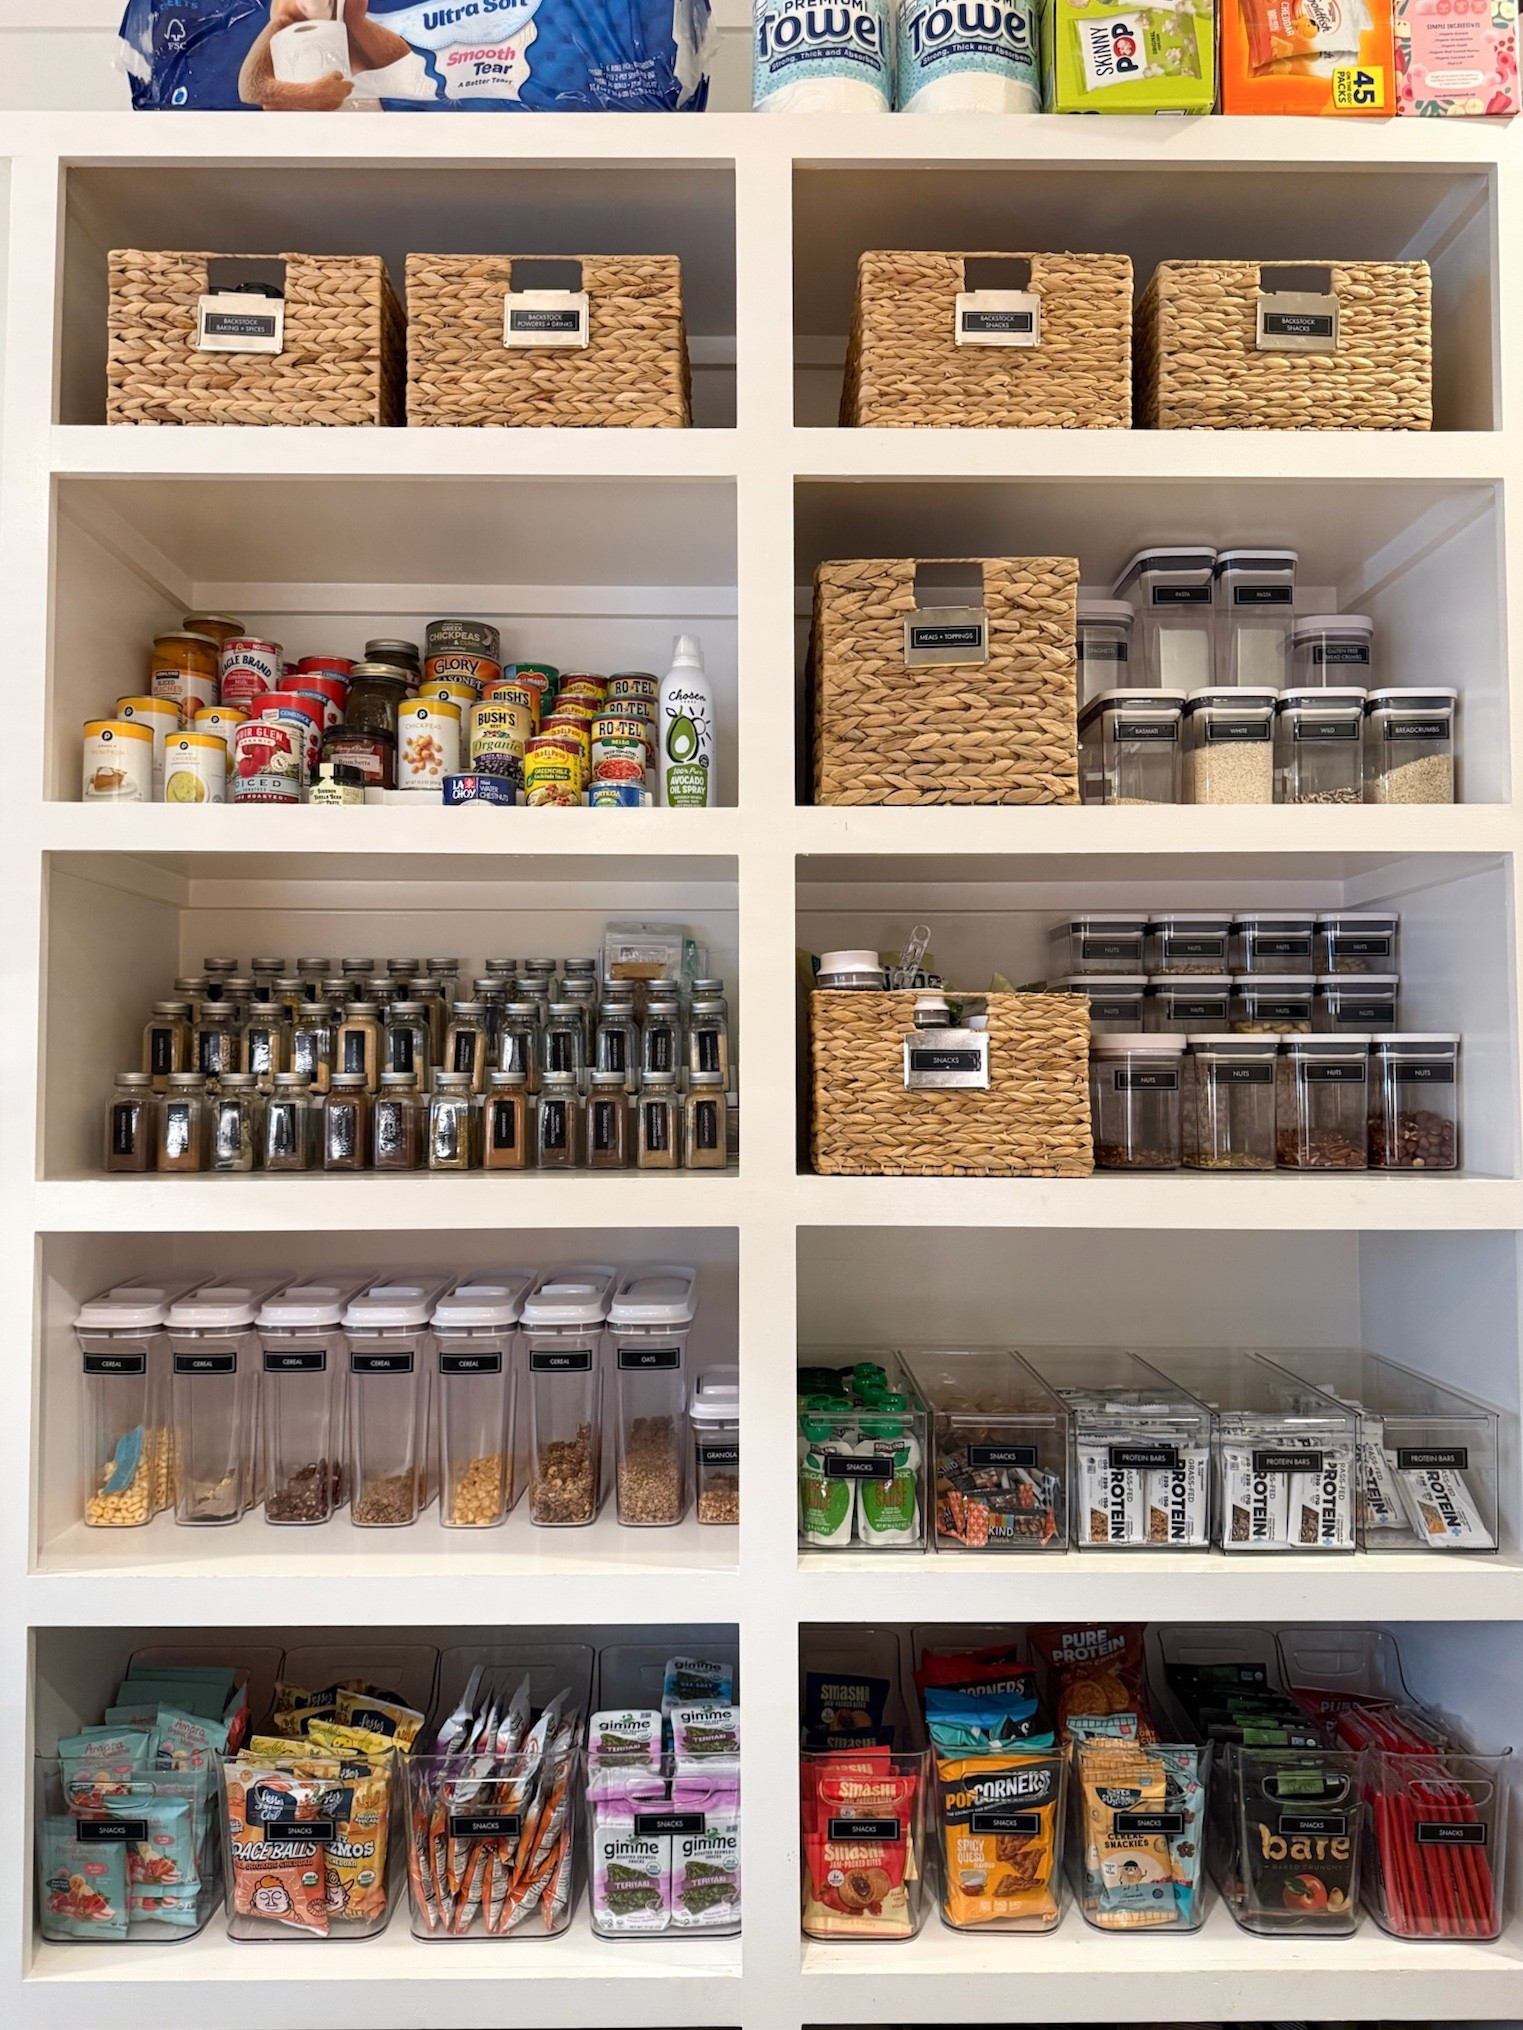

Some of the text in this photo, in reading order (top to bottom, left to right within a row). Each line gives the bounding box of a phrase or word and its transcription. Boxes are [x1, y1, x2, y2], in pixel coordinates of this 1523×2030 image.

[423, 2, 479, 30] Ultra
[168, 42, 187, 50] FSC
[952, 44, 975, 52] Thick
[977, 44, 993, 52] and
[446, 46, 516, 67] Smooth
[800, 50, 823, 59] Thick
[825, 48, 841, 56] and
[473, 61, 513, 76] Tear
[465, 79, 490, 88] Better
[1337, 71, 1346, 103] PACKS
[1353, 70, 1375, 104] 45
[430, 631, 480, 642] CHICKPEAS
[242, 654, 272, 678] BRAND
[434, 658, 479, 675] GLORY
[668, 688, 707, 701] Chosen
[280, 709, 311, 724] COMSTOCK
[477, 712, 516, 726] BUSH'S
[256, 727, 283, 742] GLEN
[1395, 726, 1440, 734] BREADCRUMBS
[452, 780, 464, 789] LA
[670, 775, 705, 786] AVOCADO
[452, 789, 477, 799] CHOY
[670, 785, 706, 795] OIL SPRAY
[933, 1056, 960, 1065] SNACKS
[1233, 1069, 1250, 1077] NUTS
[1414, 1069, 1431, 1077] NUTS
[706, 1451, 738, 1460] GRANOLA
[989, 1453, 1016, 1461] SNACKS
[1122, 1454, 1166, 1462] PROTEIN BARS
[1438, 1454, 1455, 1462] BARS
[846, 1463, 873, 1471] SNACKS
[1111, 1469, 1125, 1539] ROTEIN
[1253, 1471, 1268, 1536] ROTEIN
[988, 1527, 1014, 1537] KIND
[1061, 1629, 1108, 1649] PURE
[1052, 1635, 1126, 1662] PROTEIN
[674, 1660, 722, 1671] gimme
[680, 1709, 732, 1724] gimme
[175, 1718, 206, 1737] Amara
[599, 1719, 651, 1731] gimme
[693, 1734, 727, 1743] TERIYAKI
[472, 1822, 500, 1830] SNACKS
[656, 1820, 684, 1828] SNACKS
[993, 1819, 1018, 1827] SNACKS
[852, 1825, 876, 1833] SNACKS
[1438, 1829, 1464, 1837] SNACKS
[683, 1836, 737, 1857] gimme
[957, 1839, 985, 1852] SPICY
[1104, 1839, 1150, 1849] SNACKIES
[1259, 1822, 1350, 1861] bare
[270, 1840, 318, 1859] BALLS
[604, 1839, 660, 1860] gimme
[957, 1852, 985, 1865] QUESO
[614, 1882, 650, 1890] TERIYAKI
[691, 1876, 727, 1887] TERIYAKI
